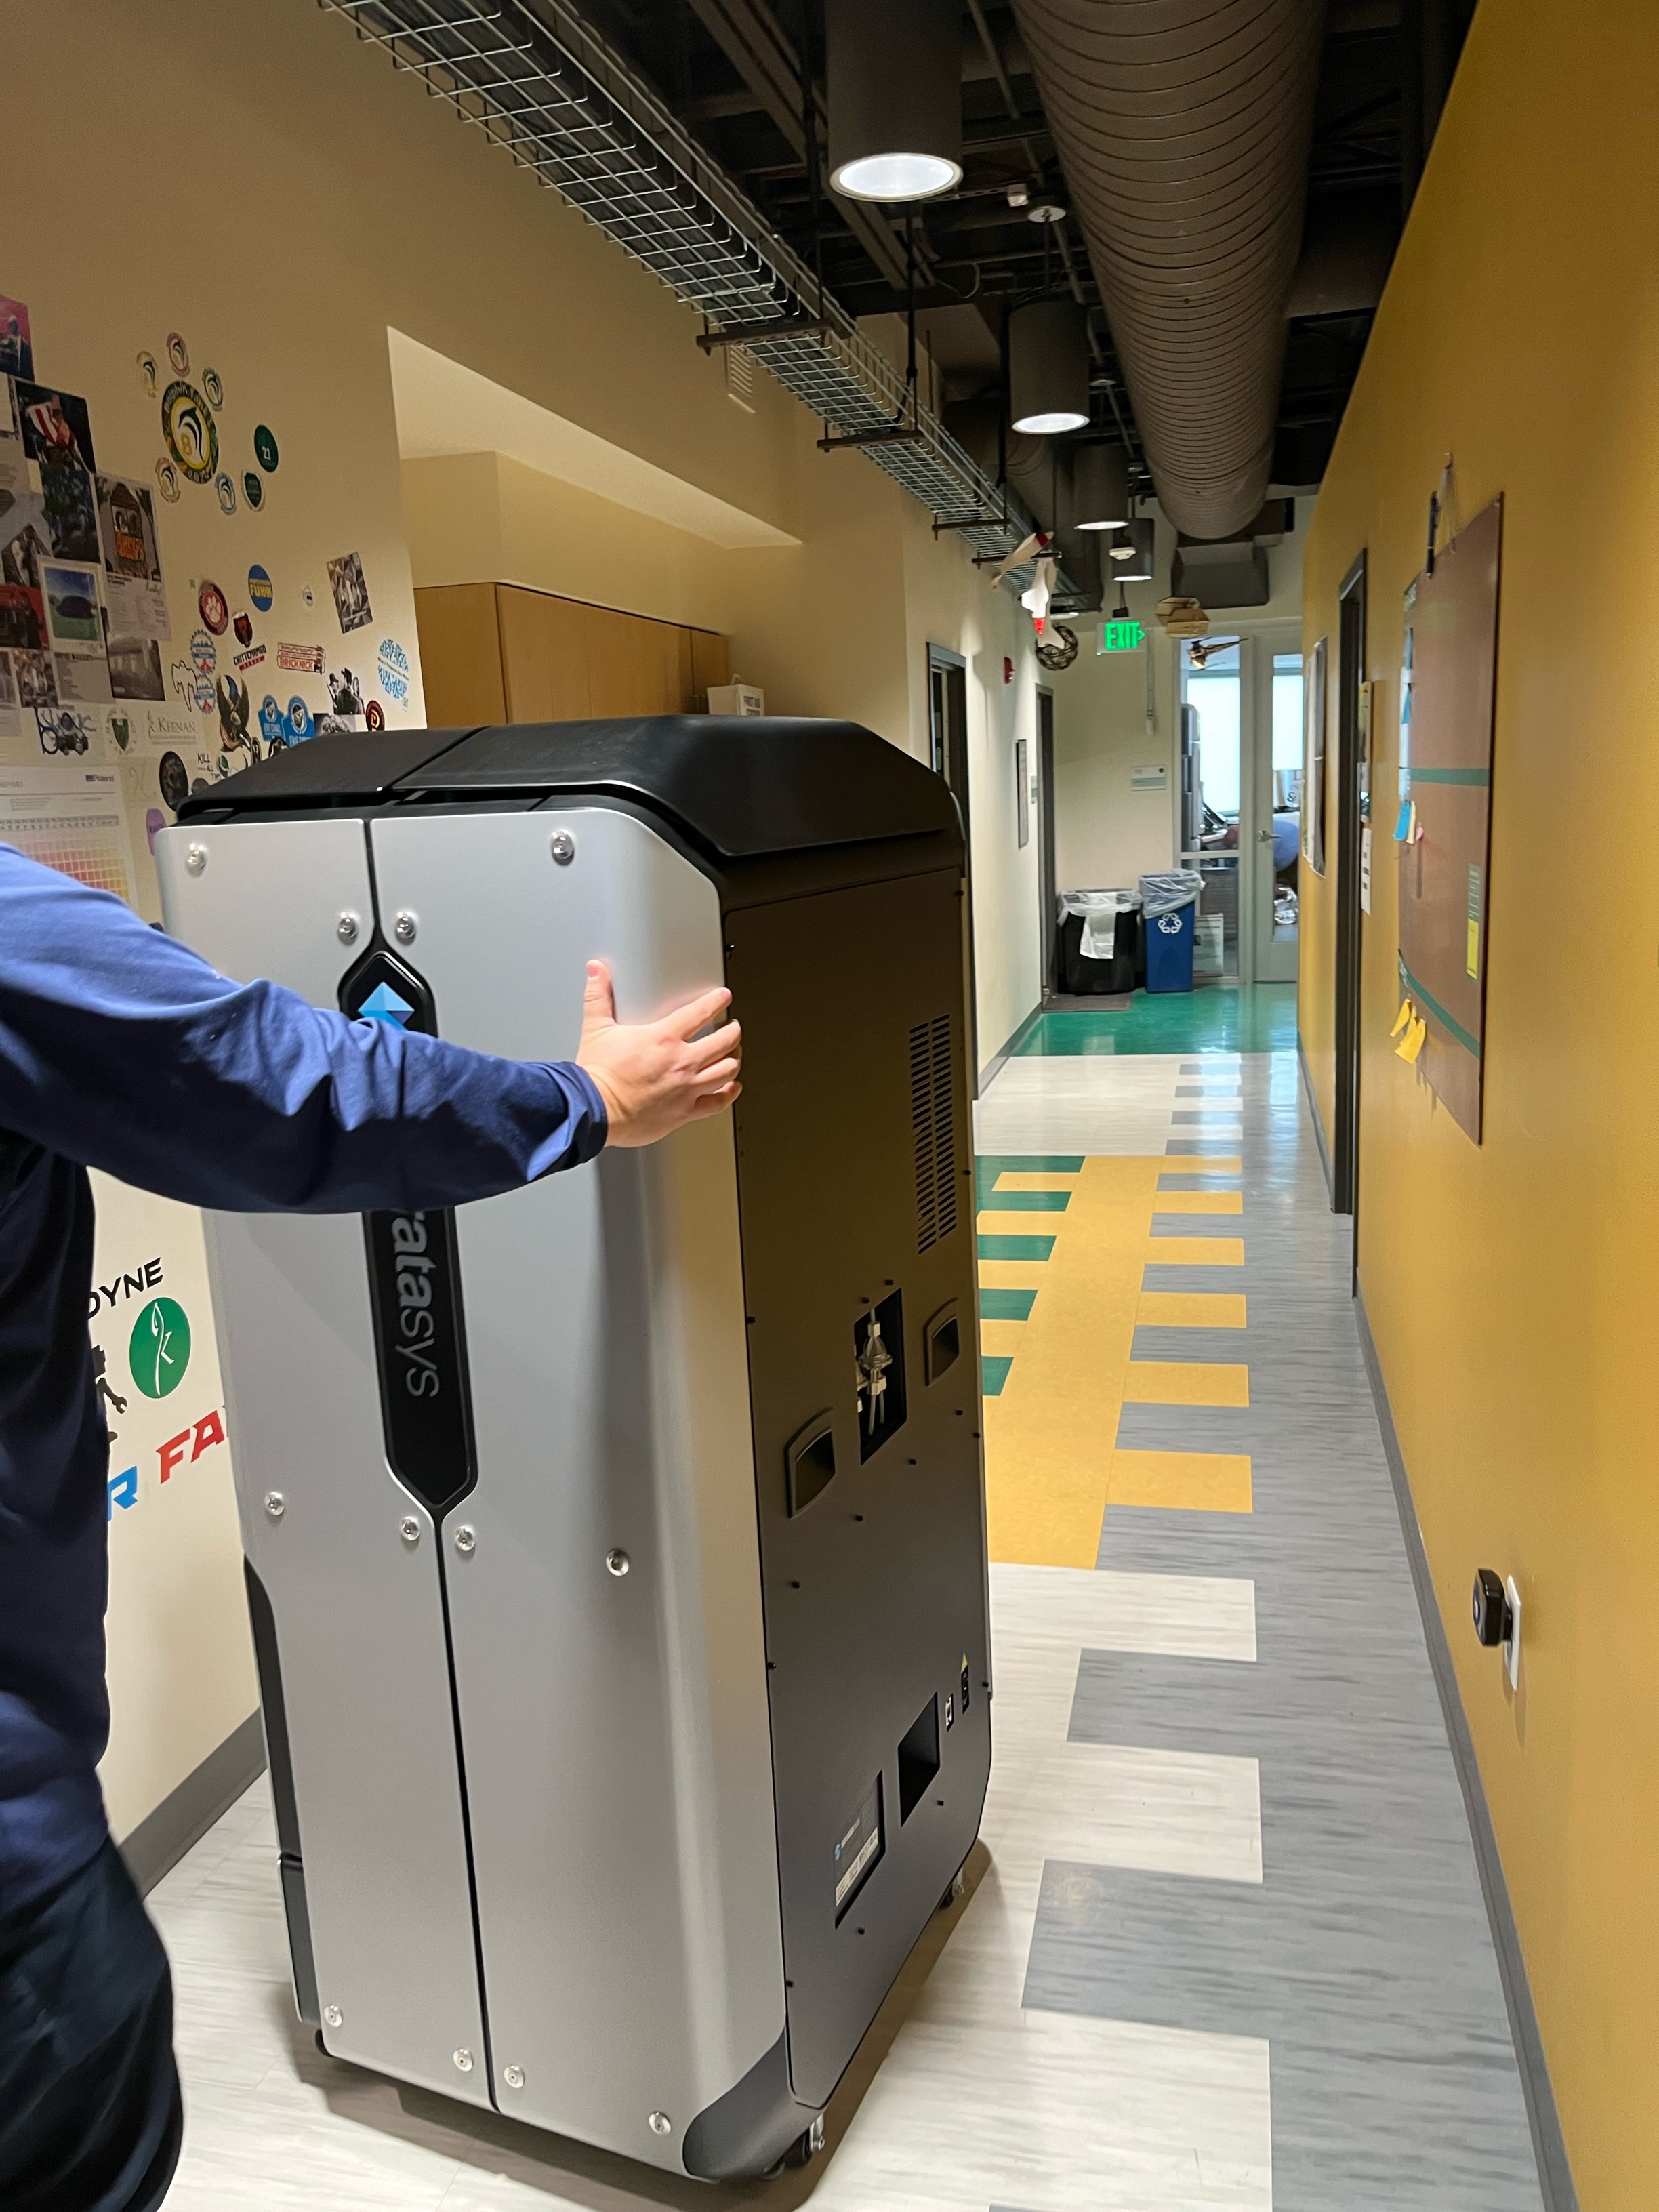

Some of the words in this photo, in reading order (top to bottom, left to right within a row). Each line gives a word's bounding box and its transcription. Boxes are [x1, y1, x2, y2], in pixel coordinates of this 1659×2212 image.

[1105, 622, 1140, 651] EXIT
[158, 716, 196, 733] KEENAN
[392, 1211, 440, 1397] atasys
